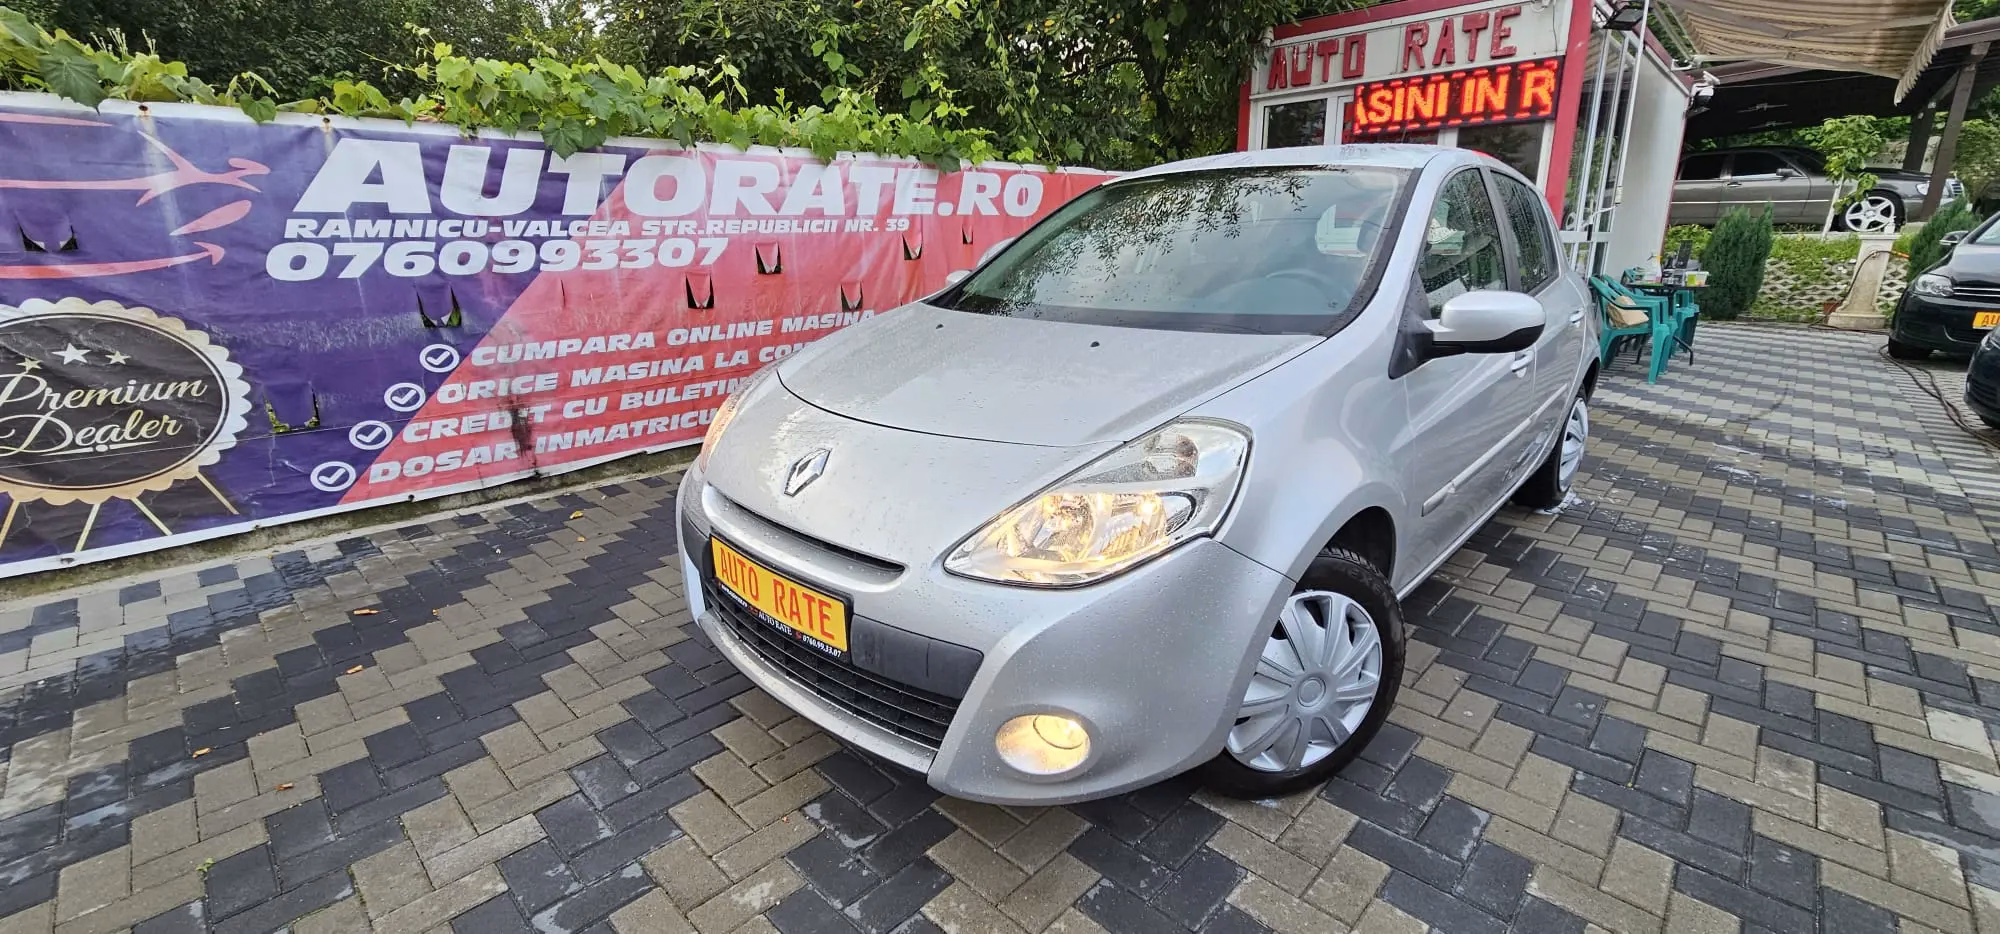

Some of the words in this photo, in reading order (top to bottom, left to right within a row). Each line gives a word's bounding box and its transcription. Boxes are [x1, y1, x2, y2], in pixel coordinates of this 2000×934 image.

[1267, 33, 1367, 89] AUTO
[1403, 7, 1521, 71] RATE
[1460, 73, 1509, 114] IN
[292, 137, 1043, 217] AUTORATE.RO
[284, 218, 630, 239] RAMNICU-VALCEA
[844, 219, 877, 233] NR.
[885, 219, 910, 232] 39
[265, 237, 728, 281] 0760993307
[471, 331, 656, 366] CUMPARA
[667, 320, 774, 346] ONLINE
[781, 309, 875, 333] MASINA
[0, 371, 208, 410] Premium
[436, 372, 558, 404] ORICE
[571, 355, 704, 387] MASINA
[714, 350, 749, 368] LA
[562, 398, 608, 419] CU
[0, 409, 182, 457] Dealer
[368, 441, 521, 484] DOSAR
[720, 547, 759, 602] AUTO
[772, 578, 835, 640] RATE
[758, 611, 775, 627] AUTO
[774, 622, 793, 636] RATE
